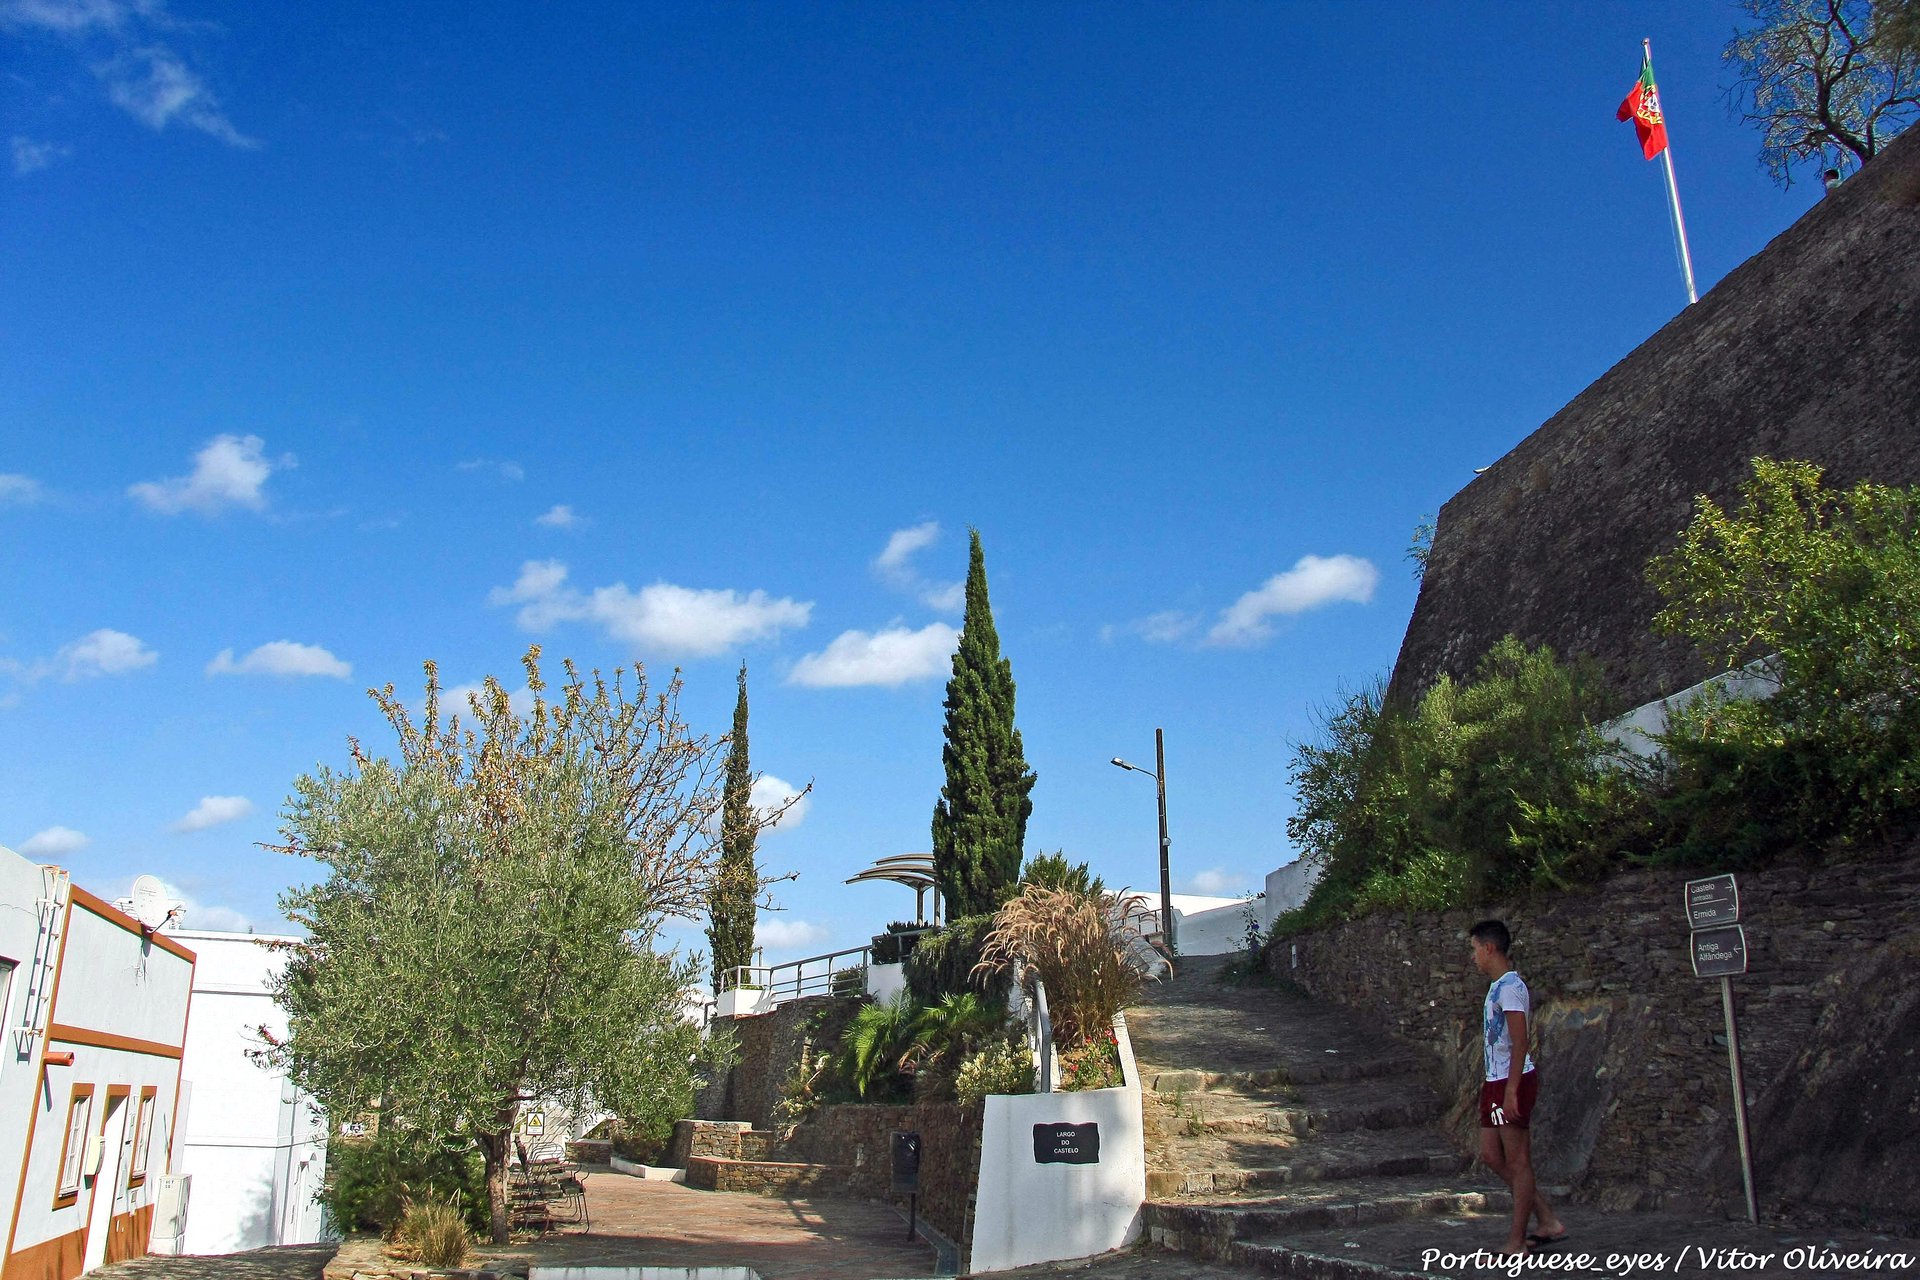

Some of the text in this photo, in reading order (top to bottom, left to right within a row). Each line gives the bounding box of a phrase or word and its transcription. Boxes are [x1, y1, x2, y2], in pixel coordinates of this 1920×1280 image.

[1690, 883, 1715, 894] Castelo
[1693, 909, 1717, 920] Ermida
[1697, 943, 1719, 953] Antiga
[1698, 950, 1733, 962] Alfândega
